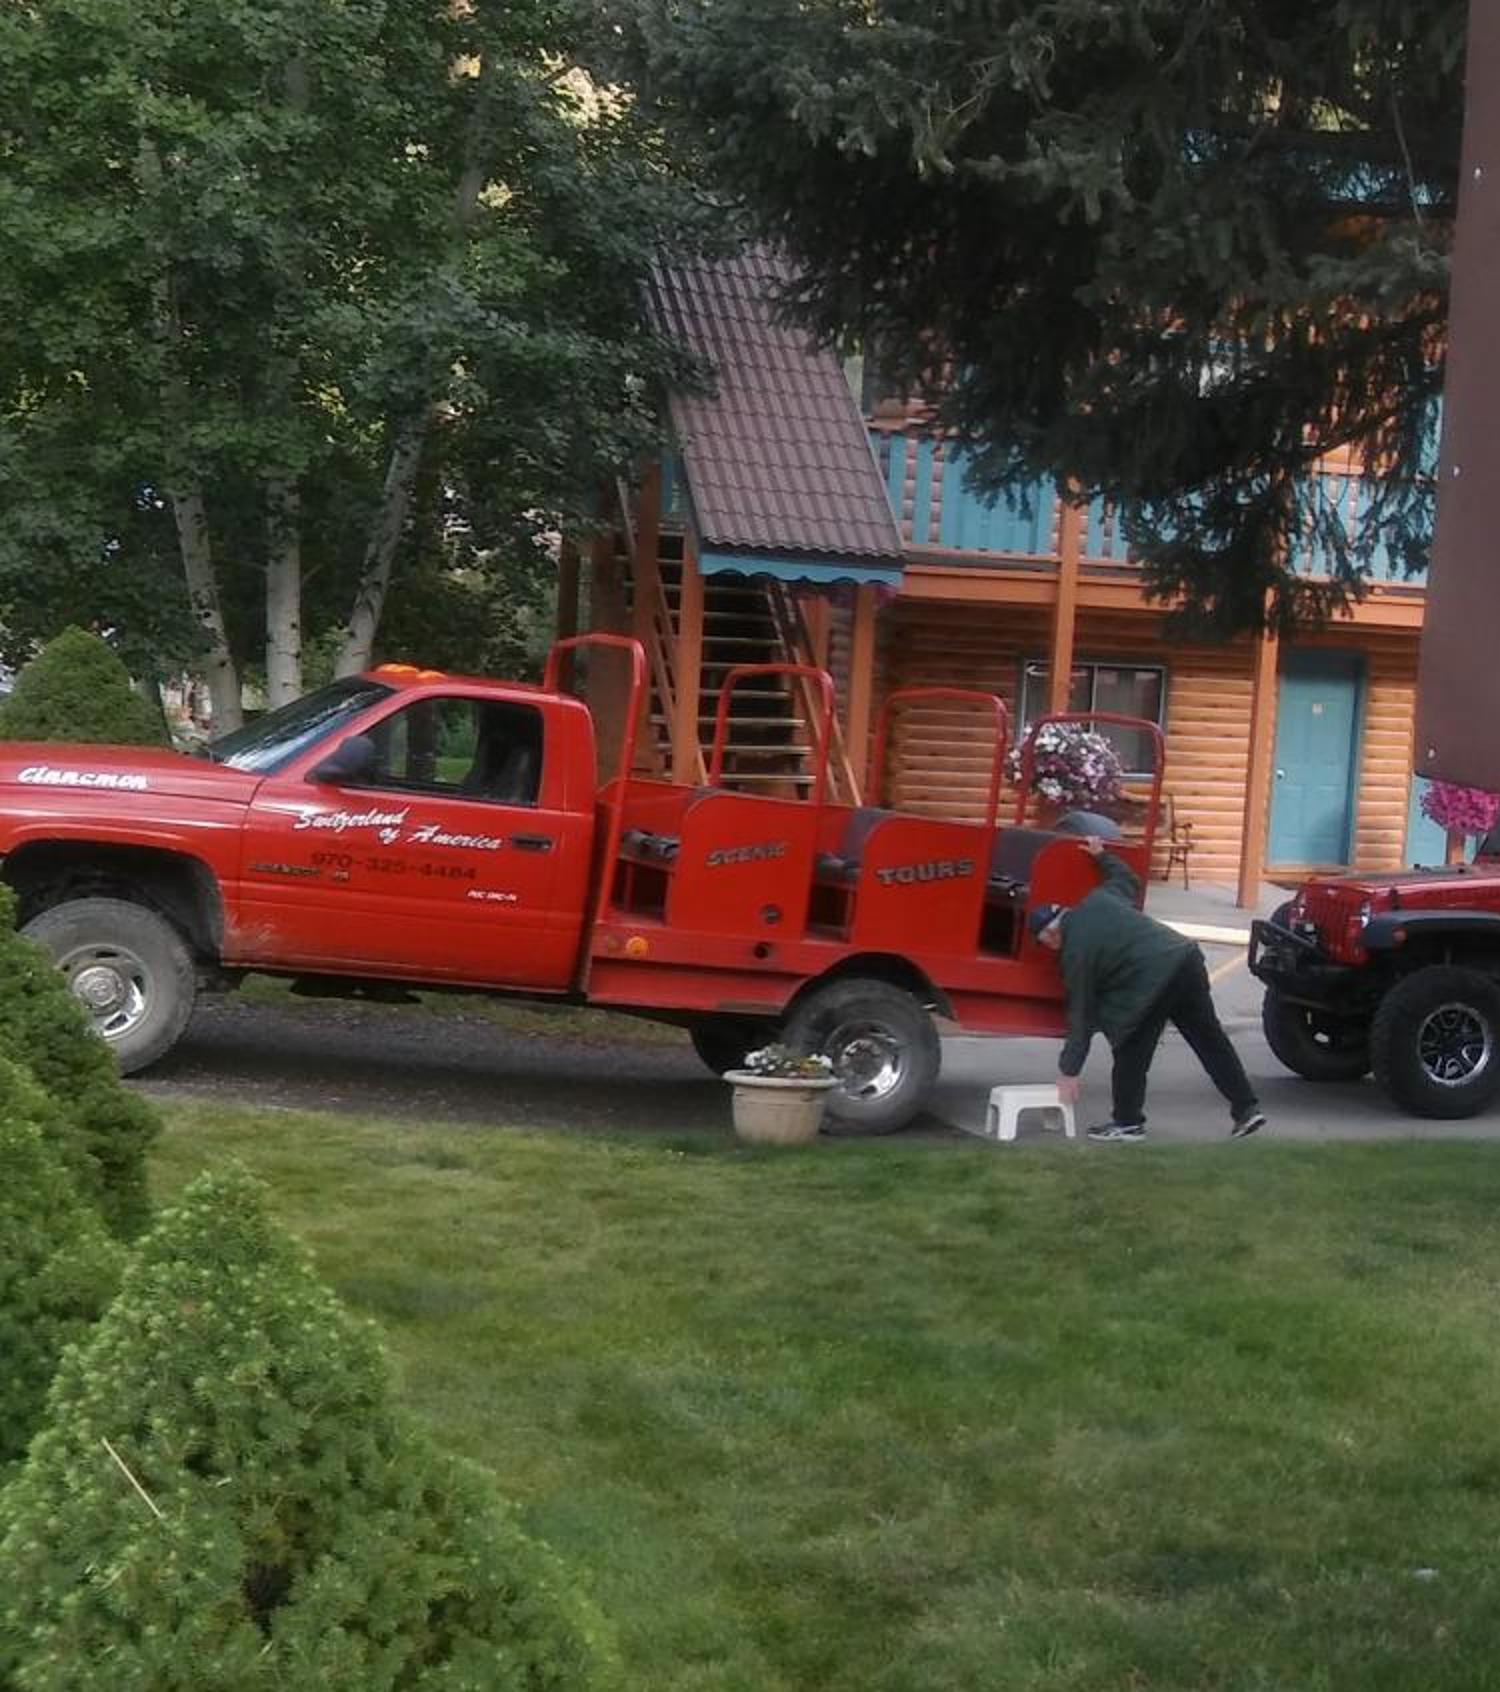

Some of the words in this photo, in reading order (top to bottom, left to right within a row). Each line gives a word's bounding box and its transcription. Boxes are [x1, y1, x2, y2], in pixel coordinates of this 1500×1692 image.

[294, 806, 410, 832] Switzerland
[379, 828, 400, 844] of
[406, 825, 502, 849] America
[877, 859, 975, 886] TOURS
